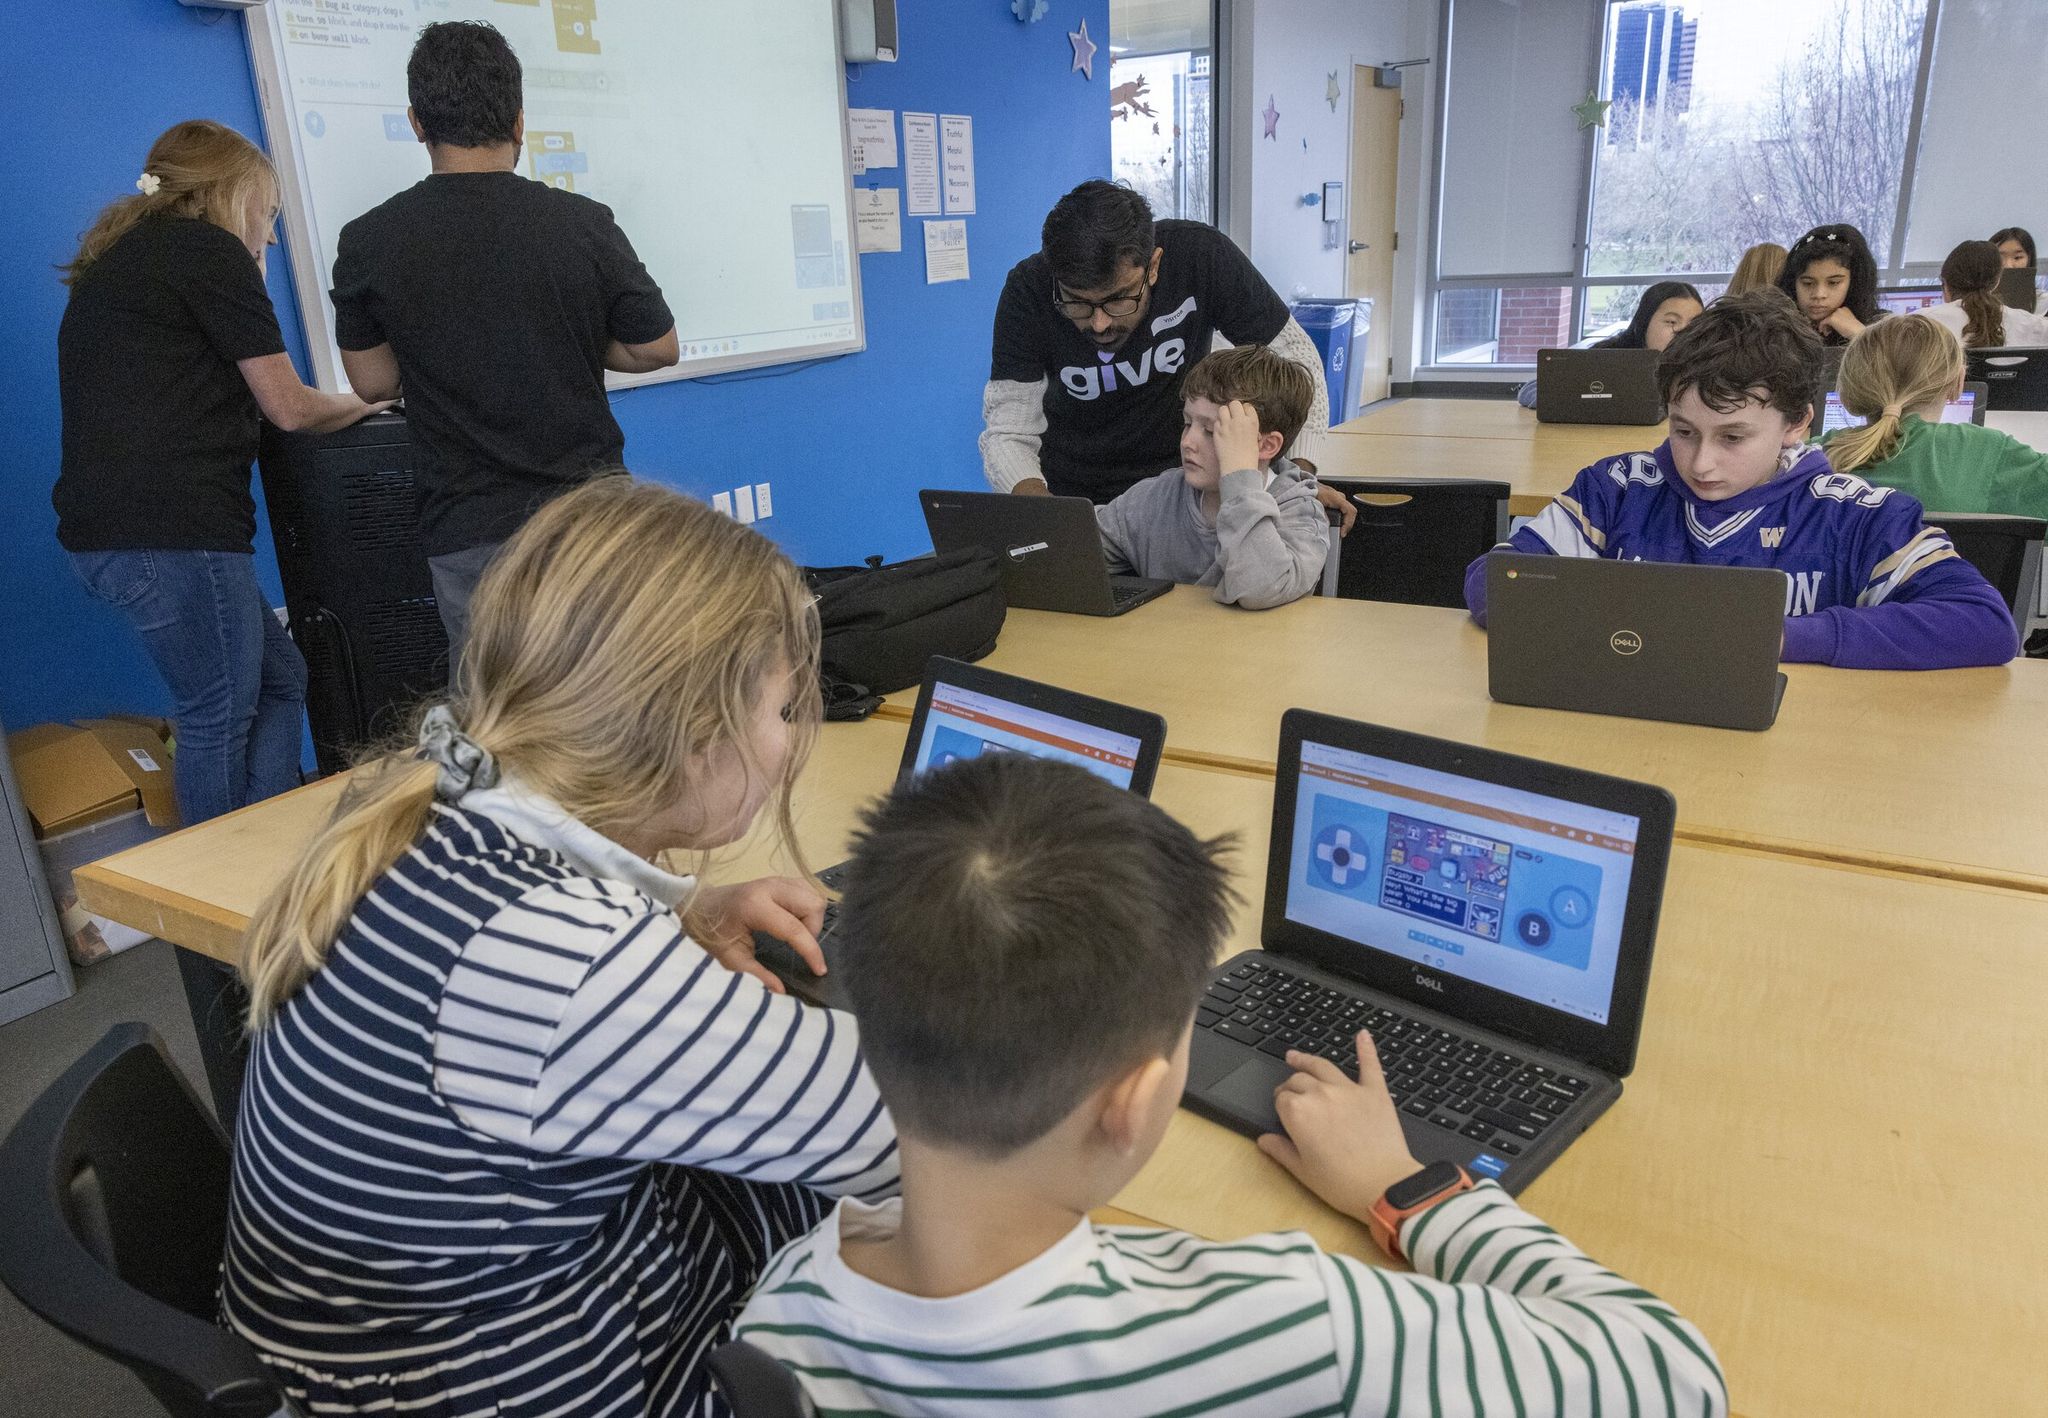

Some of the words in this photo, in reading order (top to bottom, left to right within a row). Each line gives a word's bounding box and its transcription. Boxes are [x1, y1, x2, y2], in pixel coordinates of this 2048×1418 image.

[296, 14, 314, 23] turn
[332, 34, 349, 42] wall
[1163, 309, 1184, 324] VISITOR
[1060, 338, 1186, 401] give
[1758, 526, 1786, 548] W
[1614, 638, 1639, 647] DELL
[1563, 898, 1577, 915] A
[1528, 921, 1541, 936] B
[1416, 974, 1444, 993] DELL
